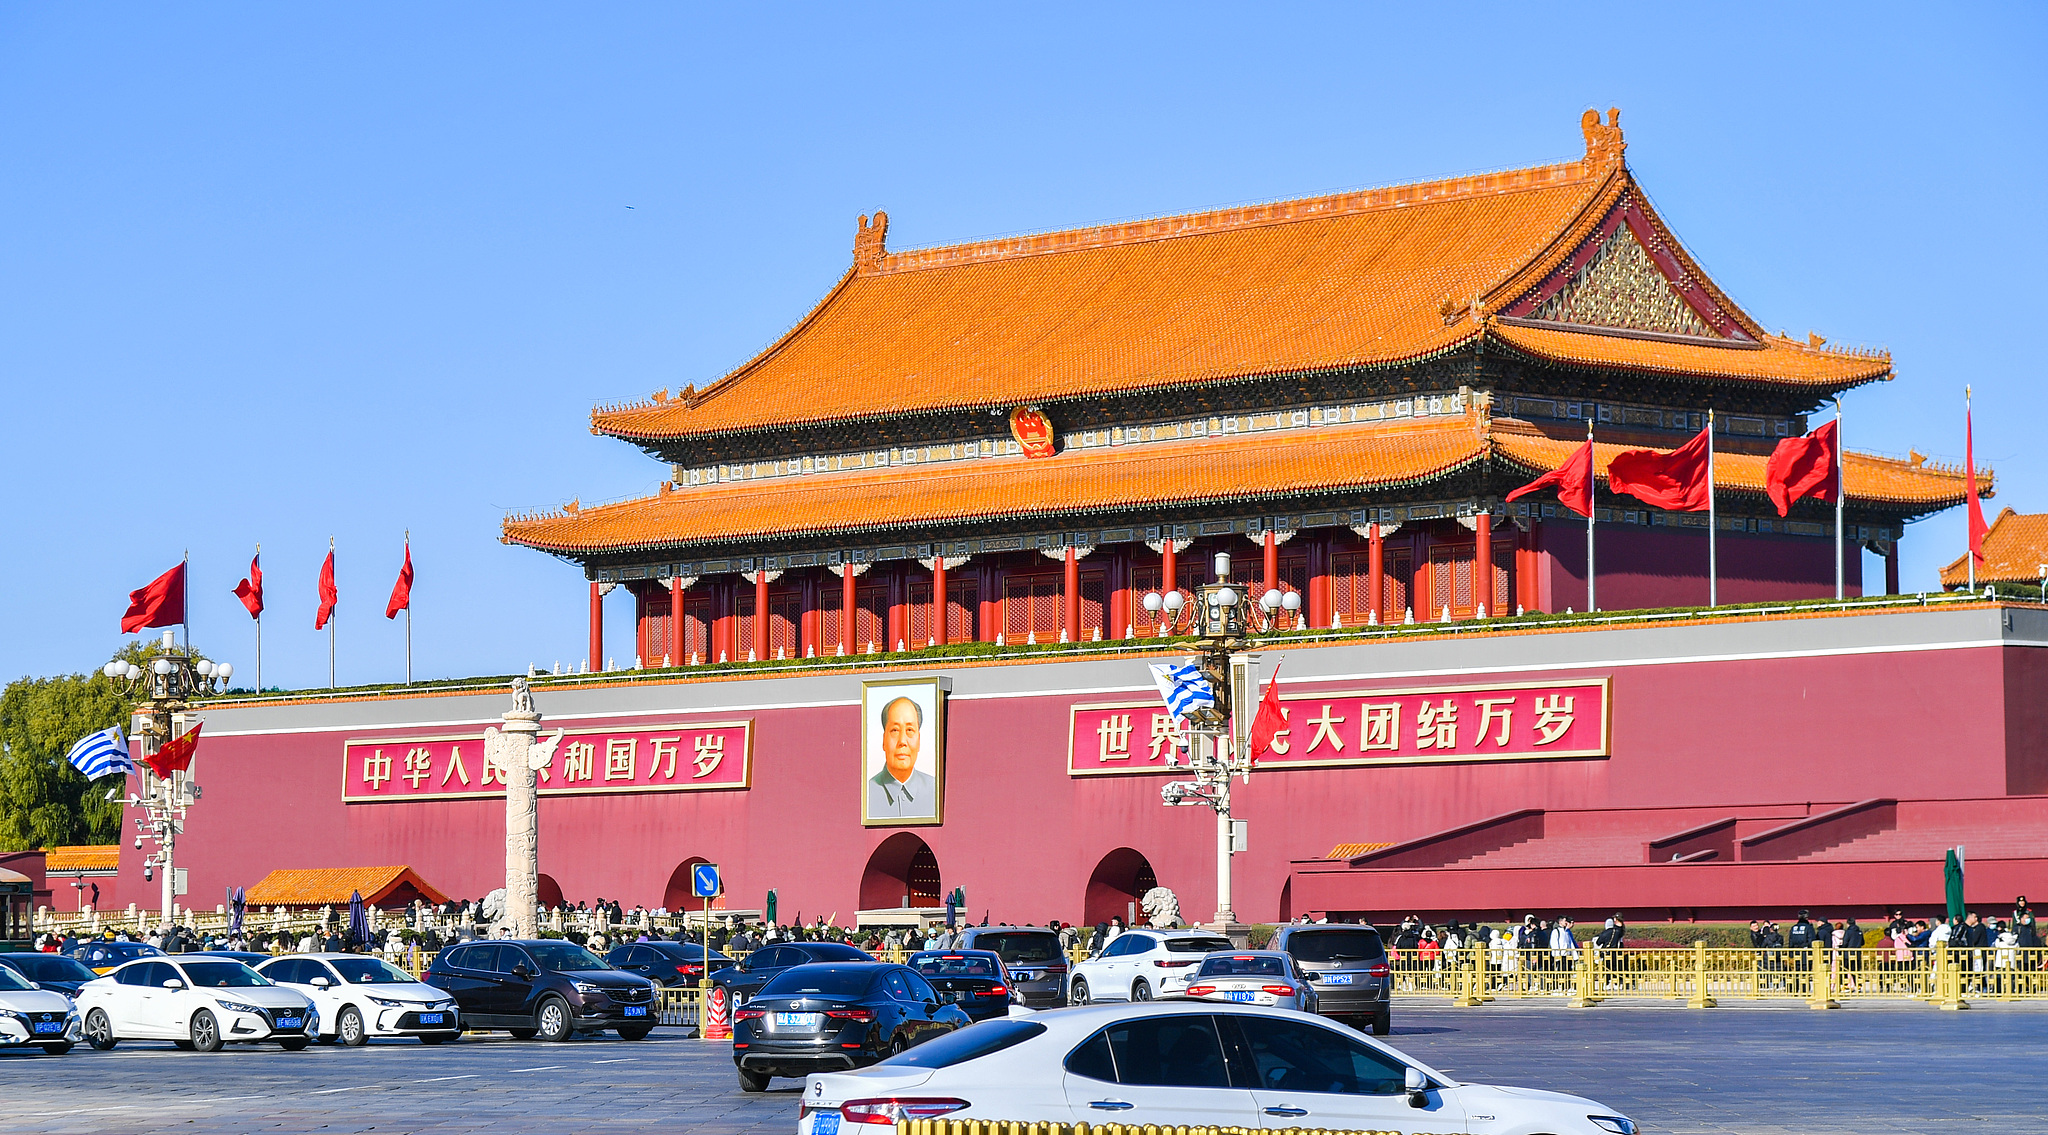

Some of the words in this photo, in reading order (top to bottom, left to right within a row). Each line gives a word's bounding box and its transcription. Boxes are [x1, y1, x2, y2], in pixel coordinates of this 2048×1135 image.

[1097, 694, 1576, 762] 世界大团结万岁
[362, 734, 725, 790] 中华人民和国万岁
